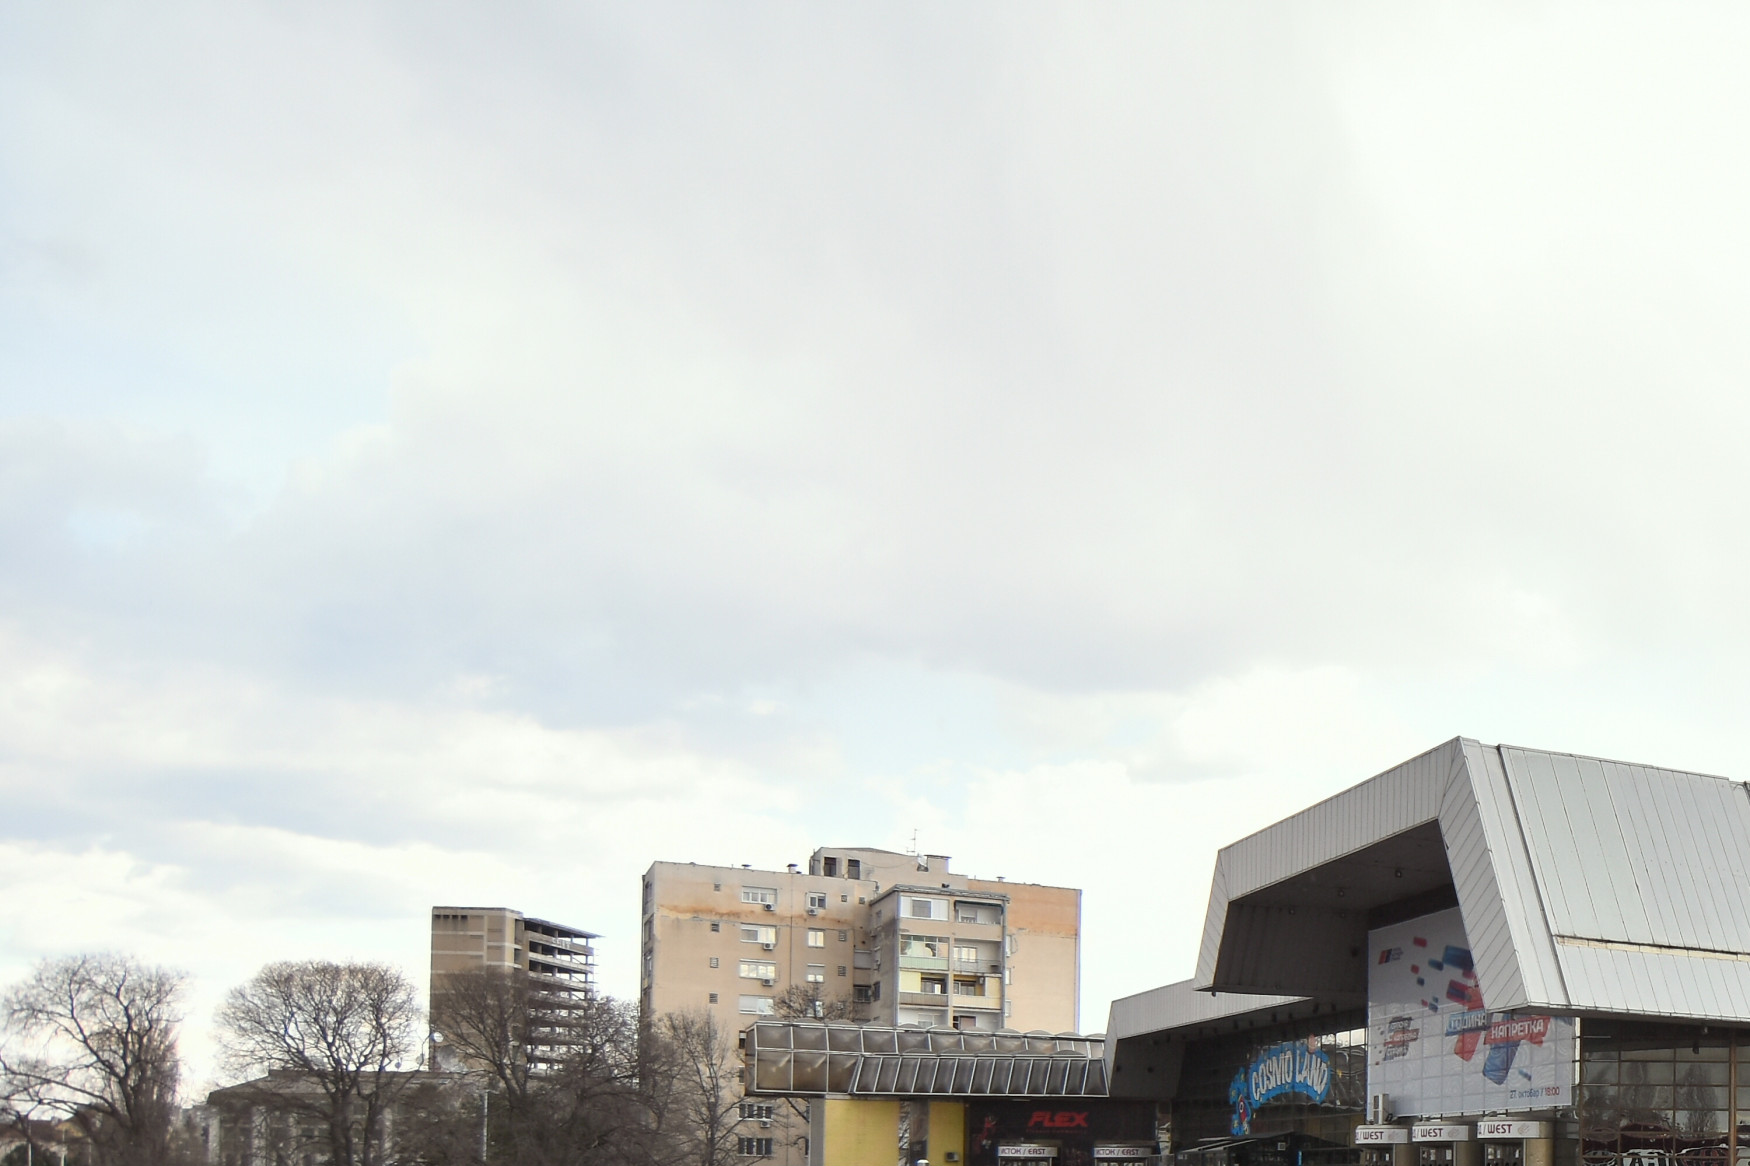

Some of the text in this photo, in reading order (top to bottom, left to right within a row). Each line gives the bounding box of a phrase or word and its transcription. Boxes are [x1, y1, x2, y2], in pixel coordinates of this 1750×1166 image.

[1491, 1019, 1544, 1039] НАПРЕТКА
[1252, 1049, 1328, 1101] COSMO LAND
[1545, 1086, 1560, 1097] 18:00
[1027, 1110, 1089, 1128] FLEX
[1420, 1127, 1444, 1138] WEST
[1487, 1123, 1513, 1134] WEST
[1362, 1130, 1385, 1140] WEST
[1121, 1148, 1140, 1156] EAST
